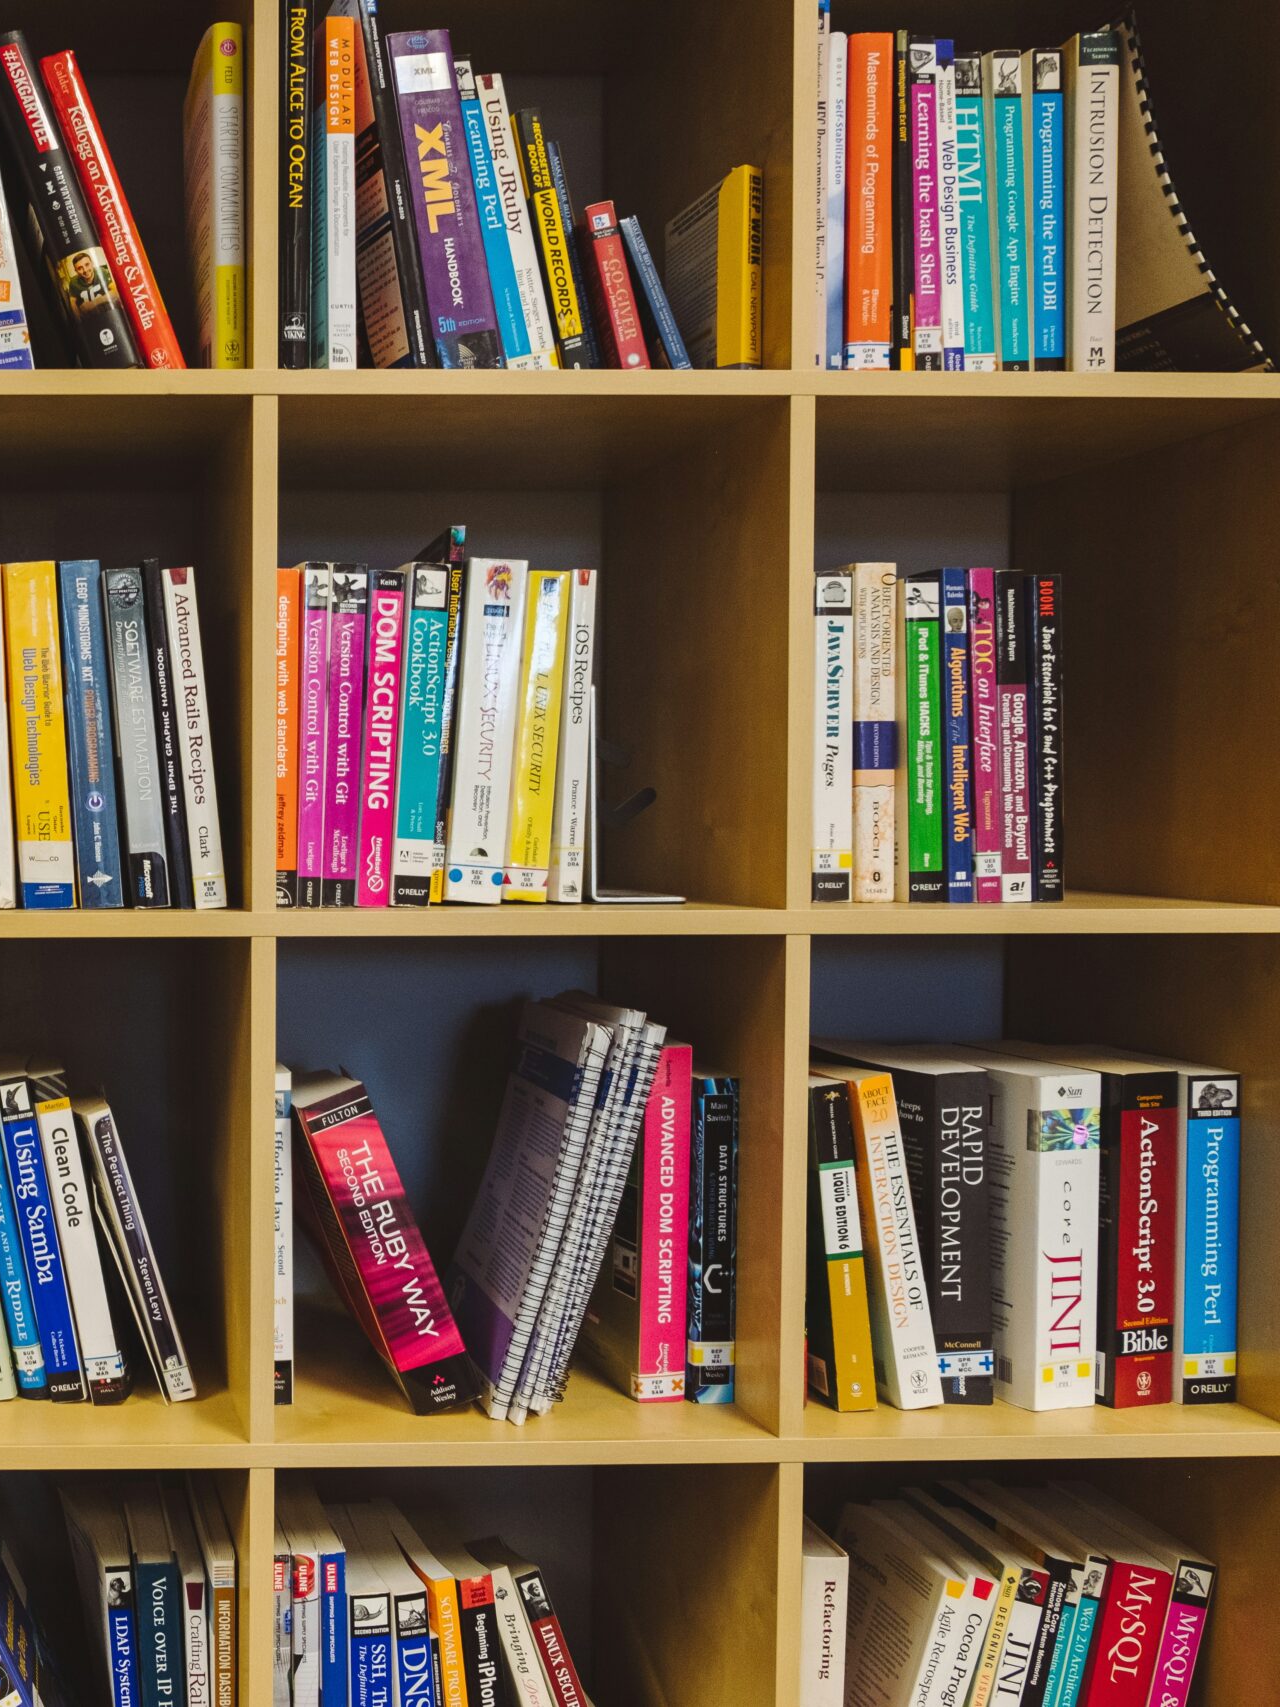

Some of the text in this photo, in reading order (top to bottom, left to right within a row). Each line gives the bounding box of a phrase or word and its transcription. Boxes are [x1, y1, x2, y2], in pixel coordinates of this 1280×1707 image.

[4, 49, 48, 146] #ASKGARYVEE
[330, 39, 339, 126] WEB DESIGN
[341, 38, 351, 126] MODULAR
[218, 106, 239, 251] STARTUP COMMUNITIES
[414, 122, 454, 233] XML
[465, 109, 501, 229] Learning Perl
[485, 99, 523, 235] Using JRuby
[861, 52, 880, 253] Masterminds of Programming
[1087, 70, 1110, 314] INTRUSION DETECTION
[941, 140, 957, 285] Web Design Business
[444, 237, 462, 305] HANDBOOK
[1040, 581, 1054, 616] BOONE
[367, 599, 398, 809] DOM SCRIPTING
[408, 618, 427, 706] Cookbook
[423, 619, 443, 755] ActionScript 3.0
[571, 624, 588, 724] iOS Recipes
[973, 622, 994, 772] TOG on Interface
[174, 593, 210, 858] Advanced Rails Recipes Clark
[824, 744, 838, 787] Pages
[52, 1128, 82, 1227] Clean Code
[717, 1144, 727, 1242] DATA STRUCTURES
[833, 1172, 846, 1202] LIQUID
[962, 1106, 983, 1184] RAPID
[12, 1128, 54, 1285] Using Samba
[351, 1139, 438, 1337] THE RUBY WAY
[658, 1096, 674, 1324] ADVANCED DOM SCRIPTING
[835, 1205, 849, 1241] EDITION
[941, 1107, 961, 1301] DEVELOPMENT
[1133, 1117, 1158, 1312] ActionScript 3.0
[1202, 1127, 1223, 1325] Programming Perl
[1043, 1250, 1083, 1356] JINI
[1122, 1330, 1167, 1353] Bible
[152, 1577, 166, 1626] VOICE
[299, 1565, 308, 1592] ULINE
[327, 1564, 336, 1591] ULINE
[218, 1600, 231, 1668] INFORMATION
[476, 1613, 489, 1659] Beginning
[504, 1613, 530, 1673] Bringing
[819, 1581, 835, 1679] Refactoring
[957, 1613, 982, 1661] Cocoa
[997, 1633, 1031, 1698] JINI
[1108, 1570, 1156, 1684] MySQL
[1165, 1612, 1197, 1686] MySQL
[157, 1678, 171, 1694] IP
